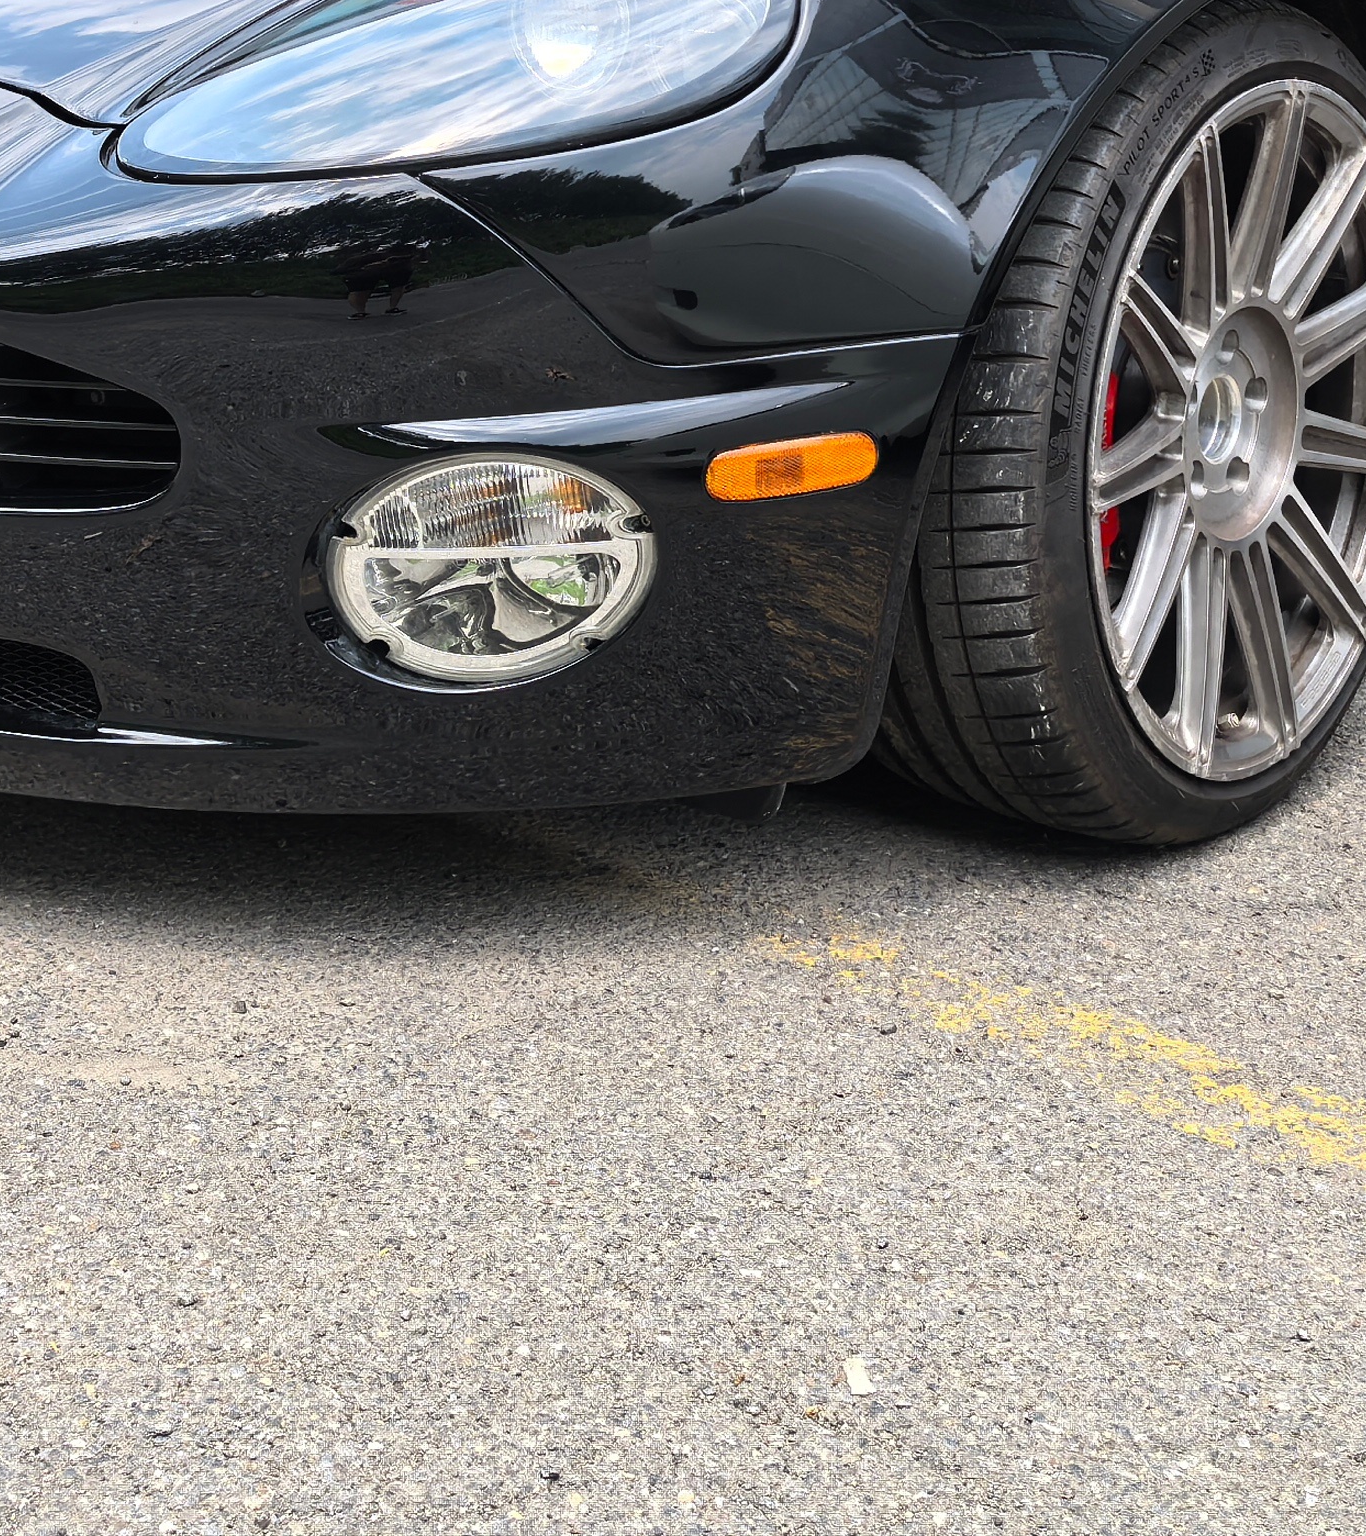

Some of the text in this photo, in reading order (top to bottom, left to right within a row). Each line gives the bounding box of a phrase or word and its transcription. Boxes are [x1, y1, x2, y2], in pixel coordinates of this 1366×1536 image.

[1123, 126, 1151, 176] PILOT
[1151, 80, 1185, 127] SPORT
[1054, 195, 1123, 415] MICHELIN
